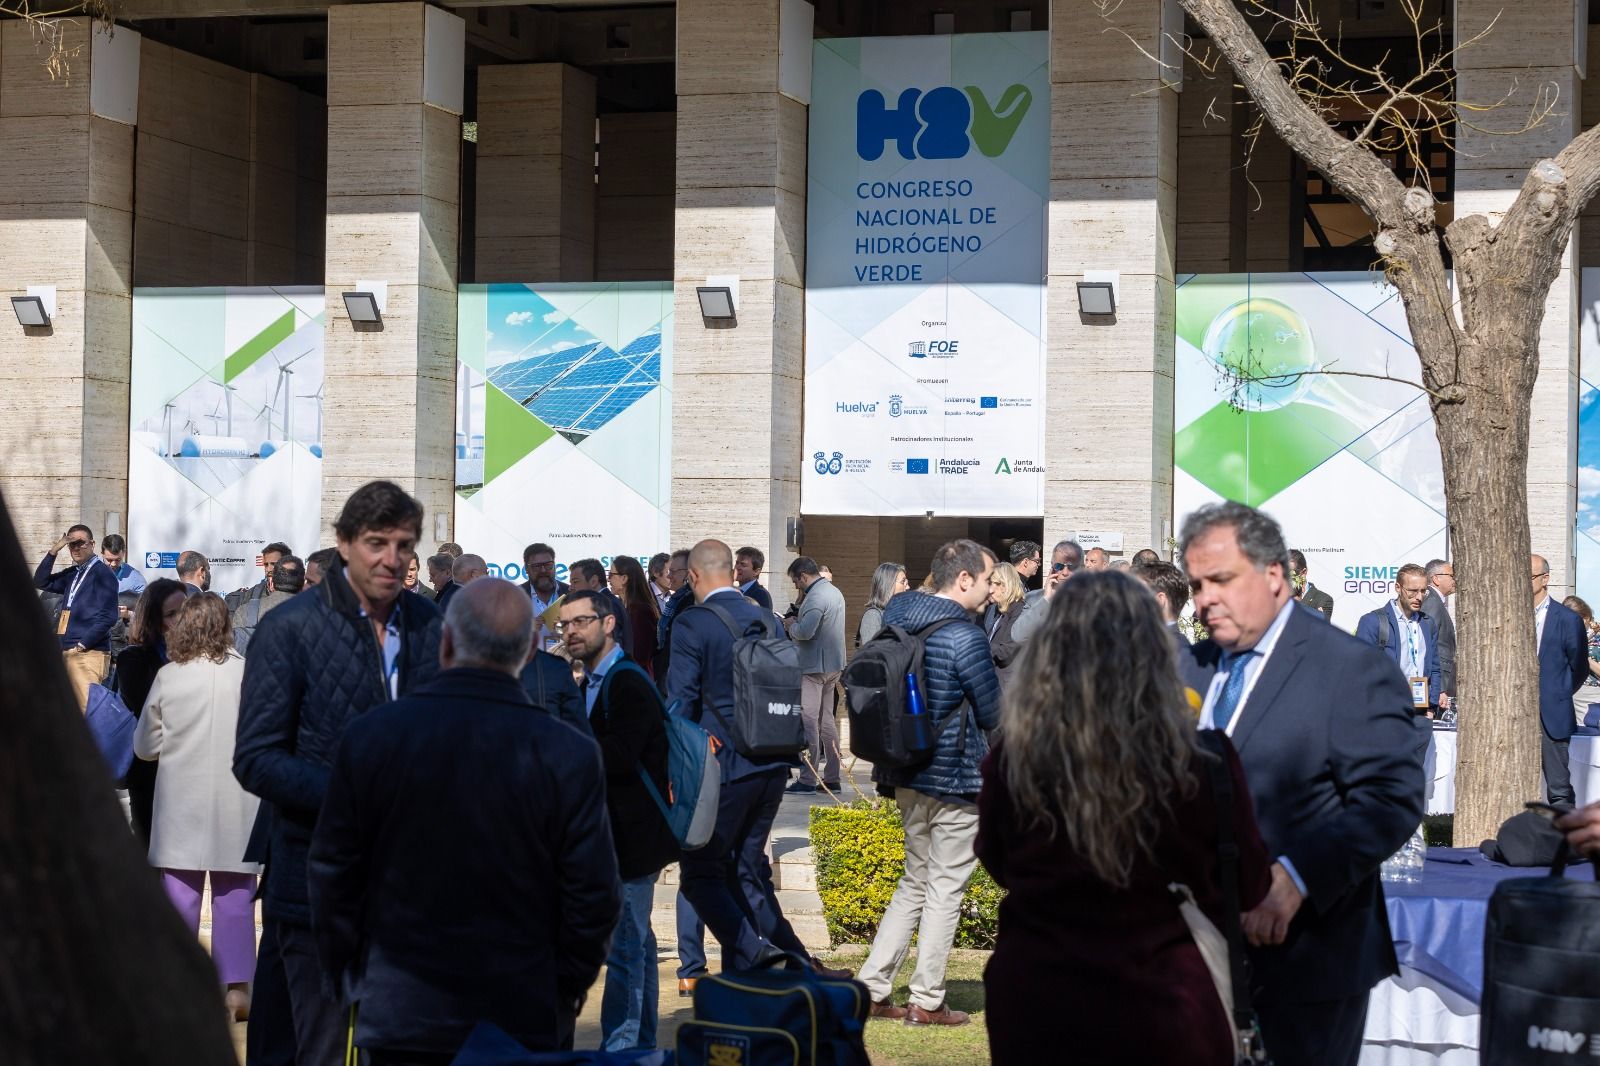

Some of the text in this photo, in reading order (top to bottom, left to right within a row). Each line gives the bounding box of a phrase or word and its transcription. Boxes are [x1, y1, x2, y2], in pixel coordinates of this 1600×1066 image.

[856, 180, 973, 199] CONGRESO
[856, 207, 997, 226] NACIONAL DE
[855, 232, 982, 254] HIDRÓGENO
[854, 264, 922, 282] VERDE
[928, 340, 959, 352] FOE
[836, 402, 876, 413] Huelva
[1344, 566, 1399, 579] SIEME
[1344, 580, 1394, 594] ener
